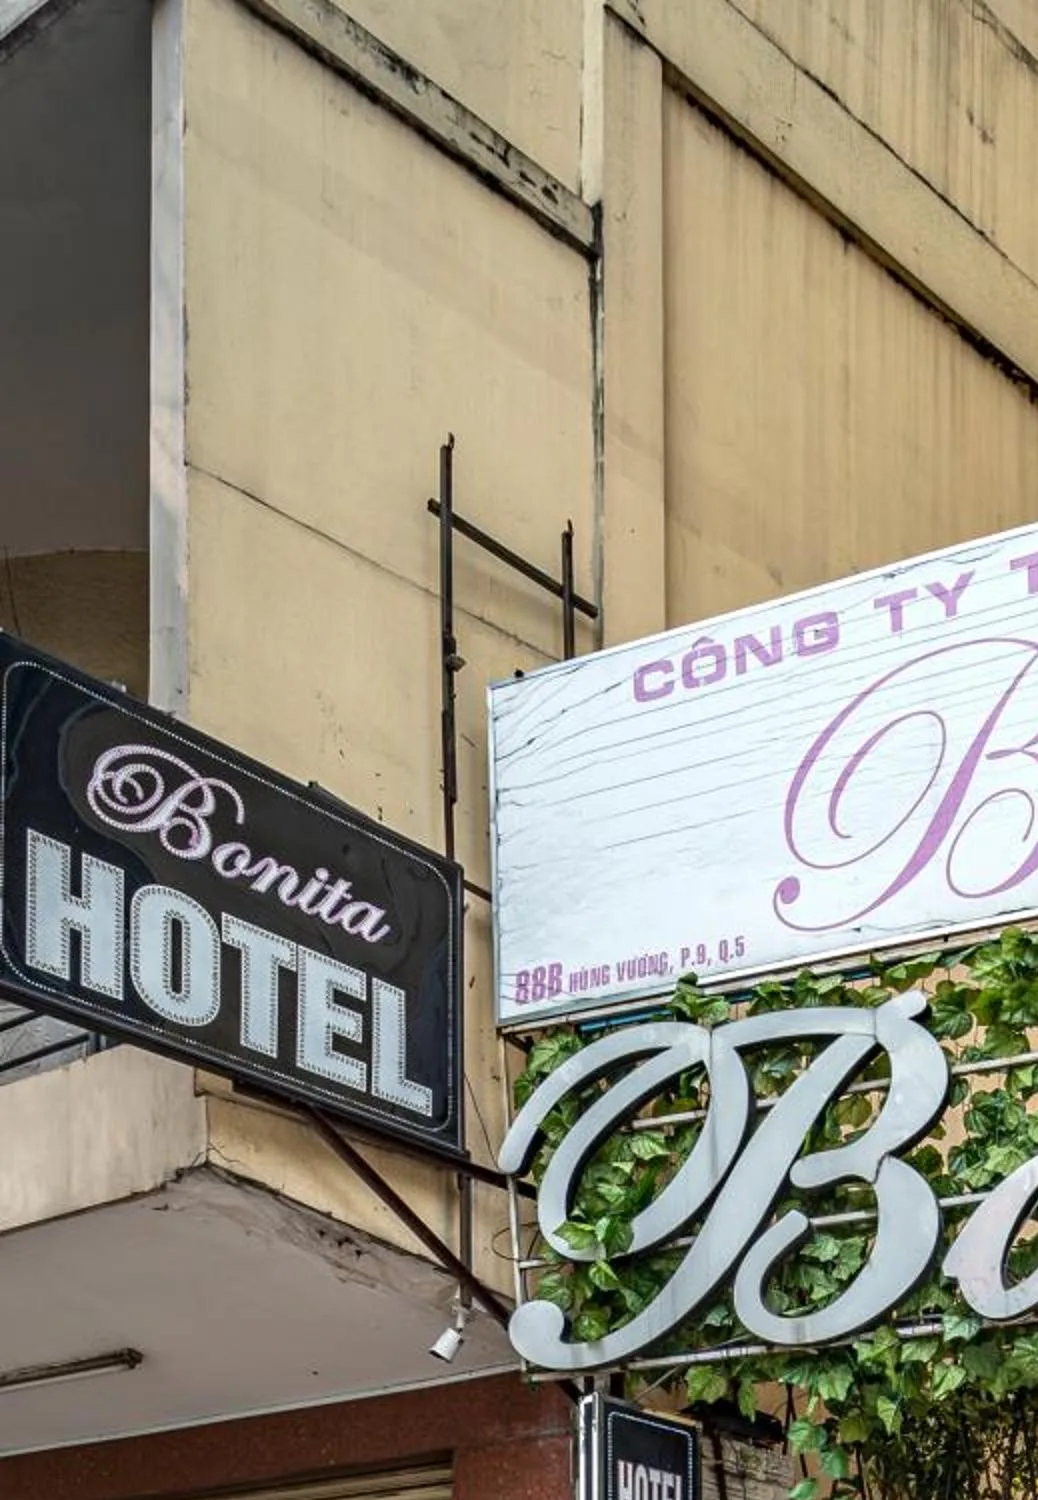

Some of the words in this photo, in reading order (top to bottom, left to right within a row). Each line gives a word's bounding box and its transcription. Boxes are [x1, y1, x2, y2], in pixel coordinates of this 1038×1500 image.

[633, 610, 841, 703] CÔNG
[873, 568, 976, 633] TY
[87, 744, 391, 943] Bonita
[25, 827, 433, 1118] HOTEL
[718, 935, 746, 962] Q.5
